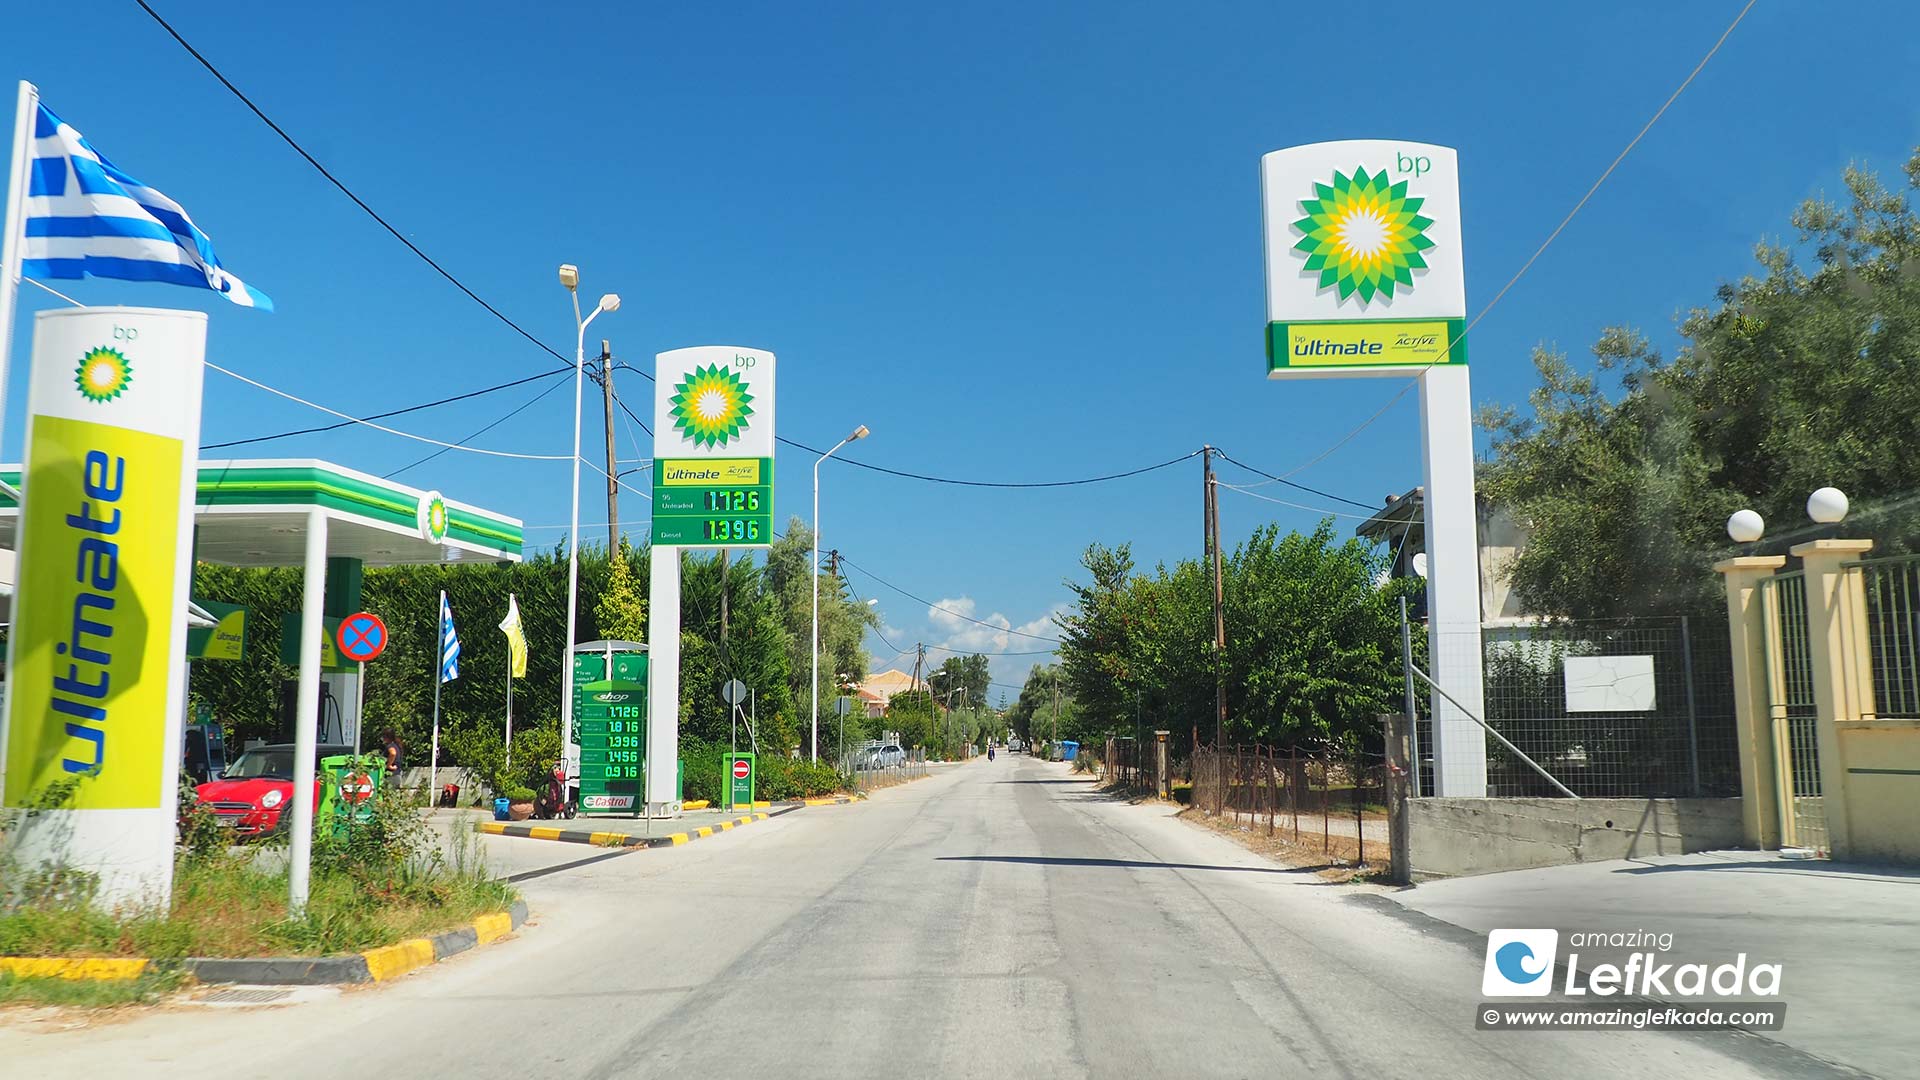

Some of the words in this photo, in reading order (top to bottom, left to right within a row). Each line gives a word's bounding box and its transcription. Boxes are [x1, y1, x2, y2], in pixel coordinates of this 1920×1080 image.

[1397, 152, 1431, 177] bp
[112, 324, 139, 345] bp
[1294, 335, 1306, 344] bp
[1395, 336, 1437, 346] ACTIVE
[1294, 339, 1383, 356] ultimate
[735, 354, 756, 370] bp
[666, 469, 720, 480] ultimate
[709, 491, 759, 511] 1.726
[709, 520, 759, 540] 1.396
[51, 449, 126, 777] ultimate
[599, 692, 629, 702] shop
[609, 706, 639, 718] 1.726
[608, 736, 638, 748] 1.396
[608, 751, 638, 763] 1.456
[595, 797, 628, 807] Castrol
